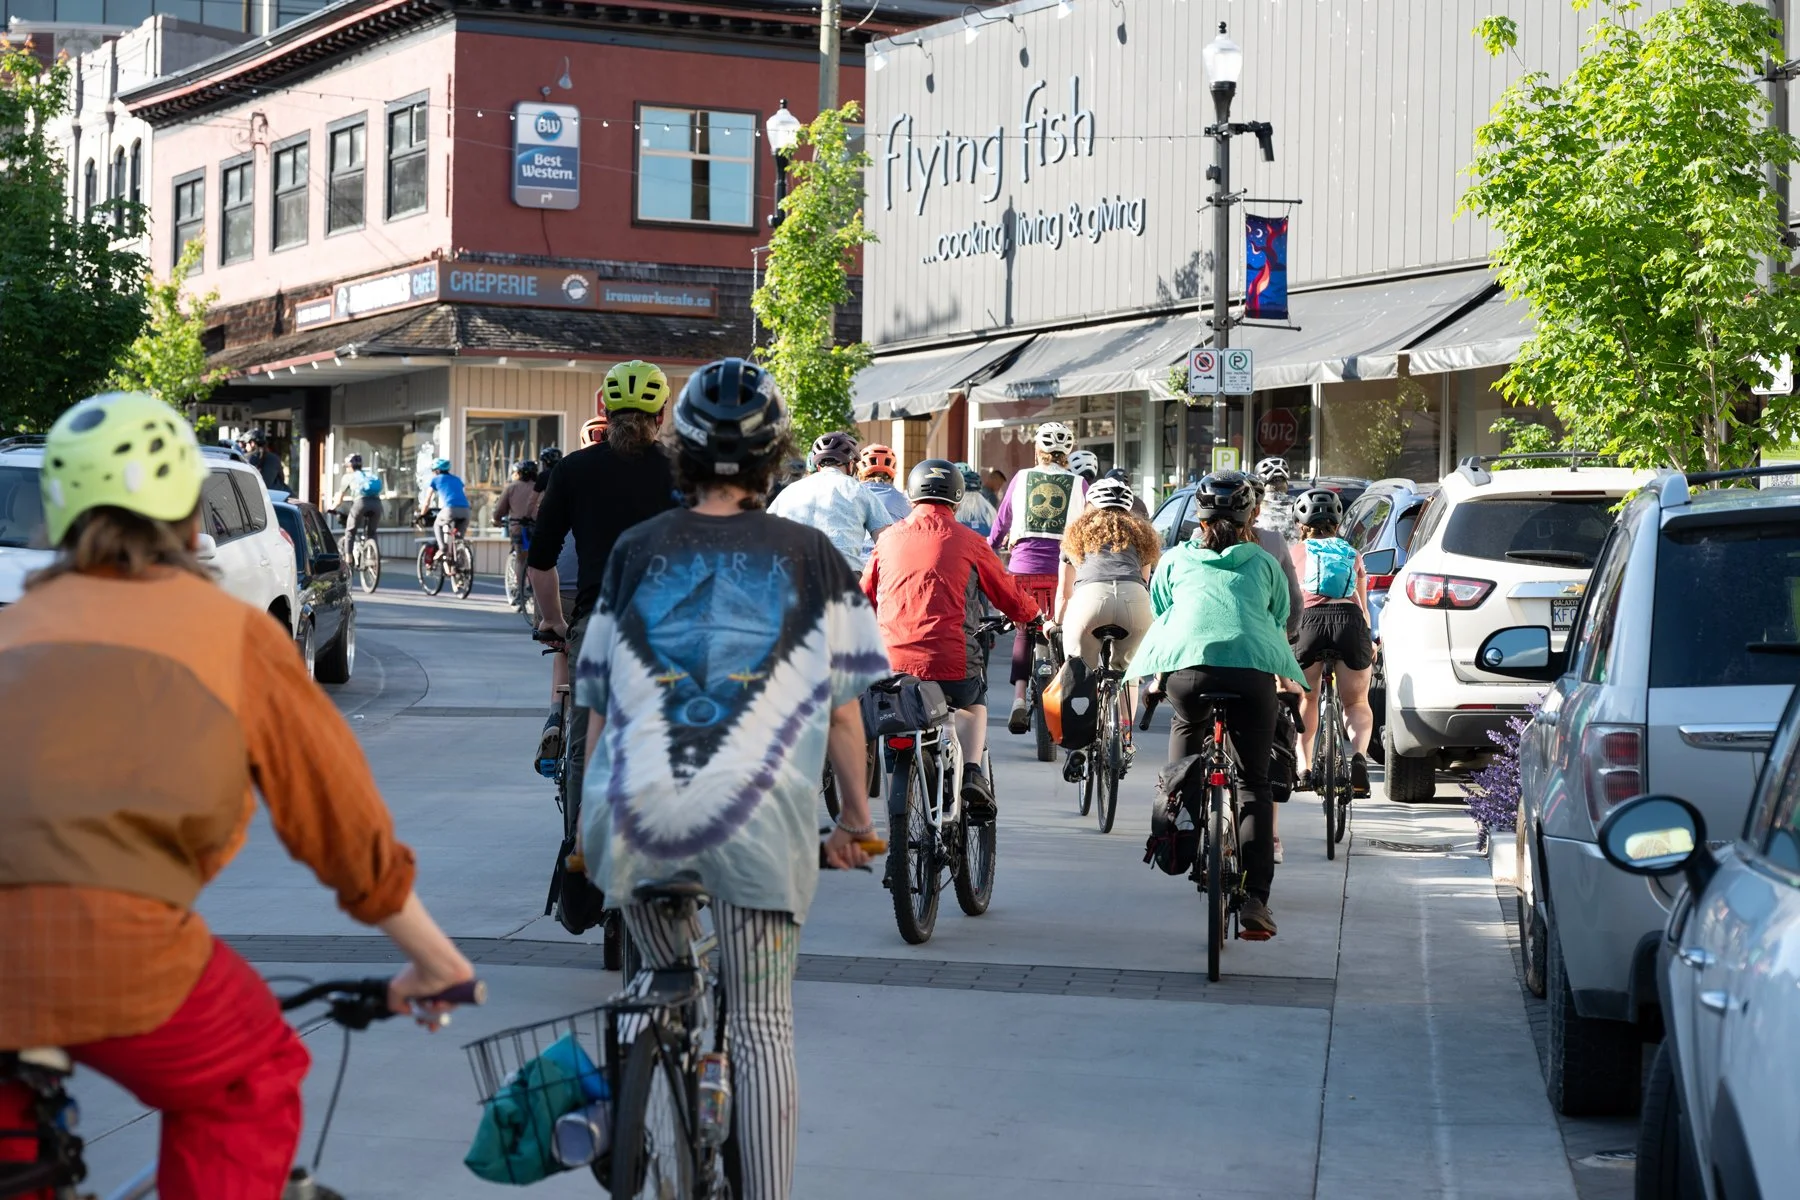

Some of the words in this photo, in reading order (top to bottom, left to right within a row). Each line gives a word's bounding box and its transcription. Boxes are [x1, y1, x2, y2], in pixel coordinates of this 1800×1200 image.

[537, 119, 560, 133] BW
[883, 113, 1003, 216] flying
[1019, 75, 1095, 184] fish
[534, 153, 562, 167] Best
[522, 164, 573, 180] Western
[1015, 208, 1063, 250] living
[1066, 202, 1083, 238] &
[1088, 195, 1146, 244] giving
[450, 267, 538, 296] CRÉPERIE
[605, 289, 711, 307] ironworkscafe.ca
[1221, 452, 1231, 467] P
[646, 552, 789, 580] DARK
